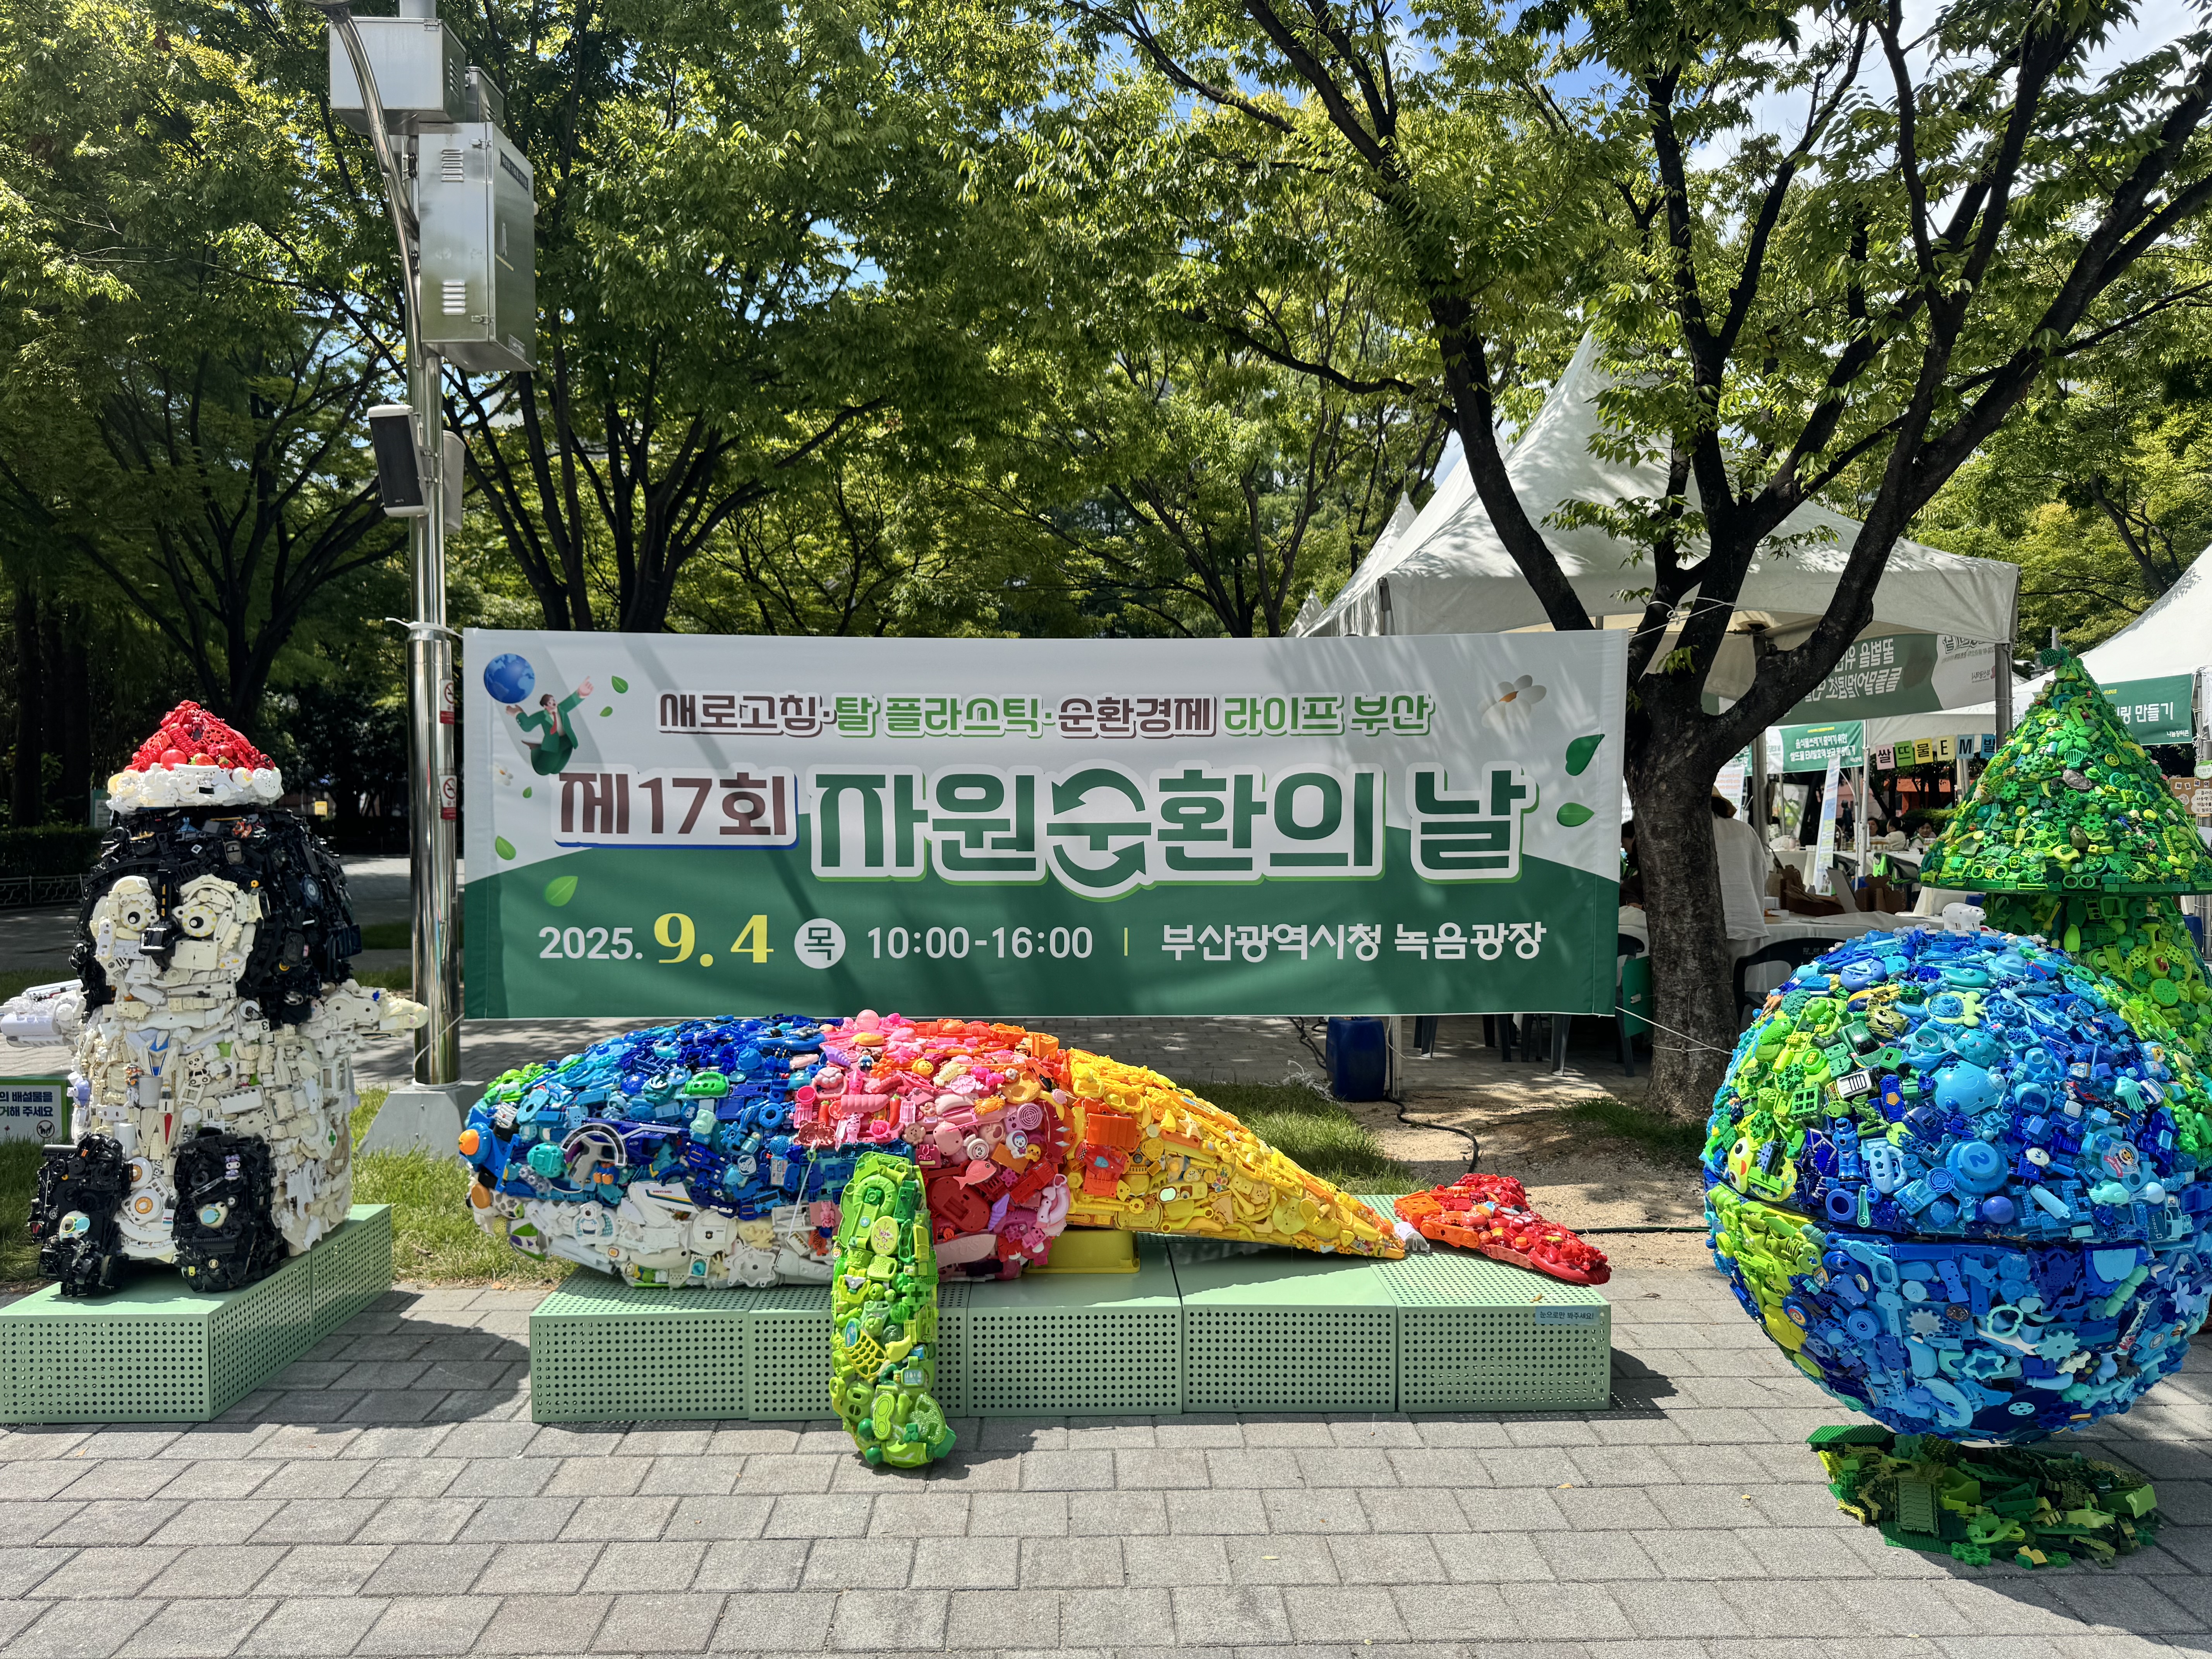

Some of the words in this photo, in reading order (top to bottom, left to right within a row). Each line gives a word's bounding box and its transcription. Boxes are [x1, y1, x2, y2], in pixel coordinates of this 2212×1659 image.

[1224, 696, 1338, 730] 라이프
[1351, 694, 1429, 730] 부산
[2135, 702, 2174, 723] 만들기
[558, 772, 787, 835] 제17회
[815, 768, 1374, 888] 자원순환의
[1415, 770, 1527, 870] 날
[539, 926, 643, 960] 2025.
[730, 914, 774, 963] 4
[867, 926, 1093, 959] 10:00-16:00
[1161, 923, 1382, 963] 부산광역시청
[1394, 921, 1547, 960] 녹음광장
[795, 1072, 804, 1080] 2
[12, 1091, 53, 1103] 배설물을
[23, 1106, 53, 1117] 주세요
[1968, 1152, 1990, 1168] 2
[1540, 1311, 1565, 1319] 눈으로만
